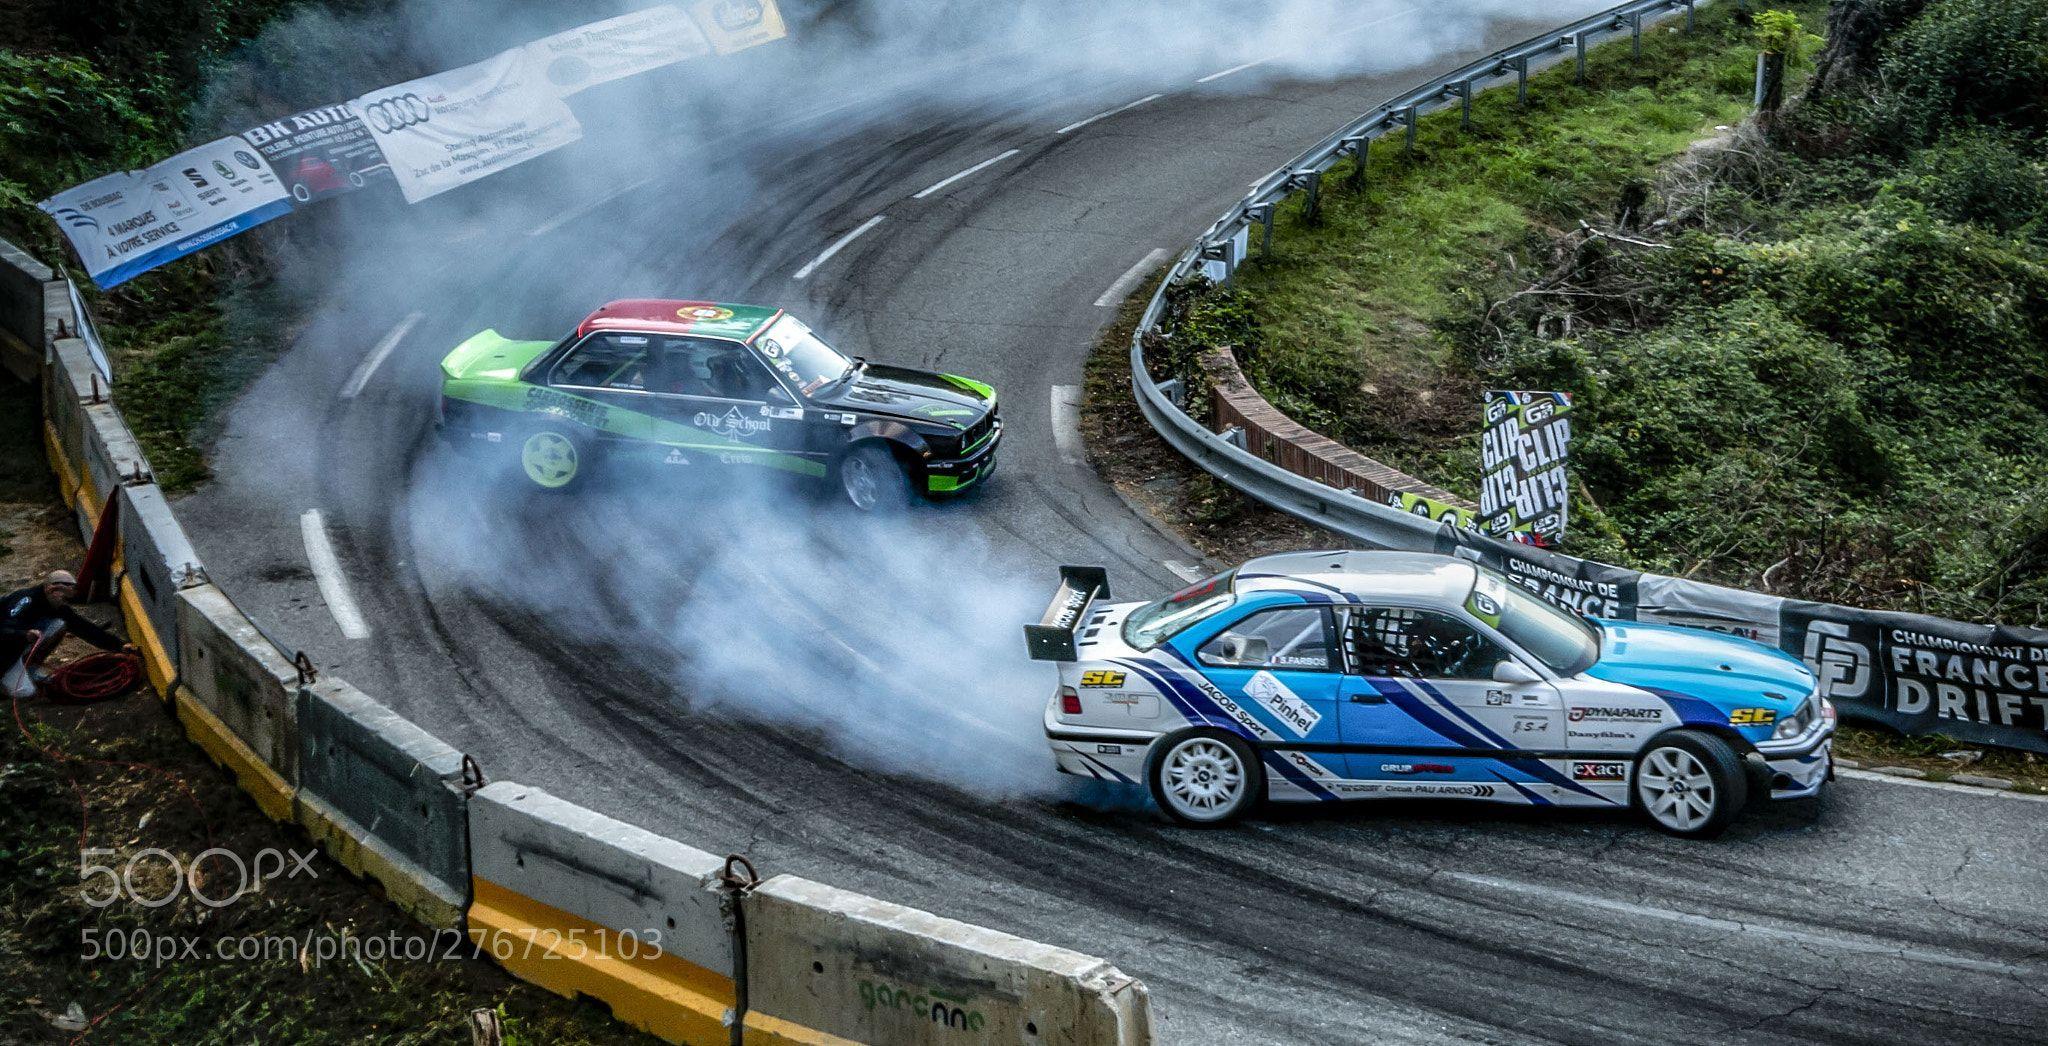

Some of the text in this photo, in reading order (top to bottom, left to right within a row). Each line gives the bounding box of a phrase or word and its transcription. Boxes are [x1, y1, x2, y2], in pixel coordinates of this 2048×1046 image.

[112, 210, 156, 235] MARQUES
[114, 235, 145, 254] VOTRE
[142, 221, 181, 243] SERVICE
[1482, 417, 1520, 470] CLIP
[1517, 418, 1571, 472] CLIP
[1597, 582, 1619, 598] DE
[1198, 682, 1238, 713] JACOB
[1237, 711, 1268, 736] Sport
[1270, 694, 1313, 732] Pinhel
[1584, 707, 1662, 719] DYNAPARTS
[1897, 677, 2048, 731] DRIFT
[1414, 786, 1436, 794] PAU
[1437, 786, 1474, 796] ARNOS
